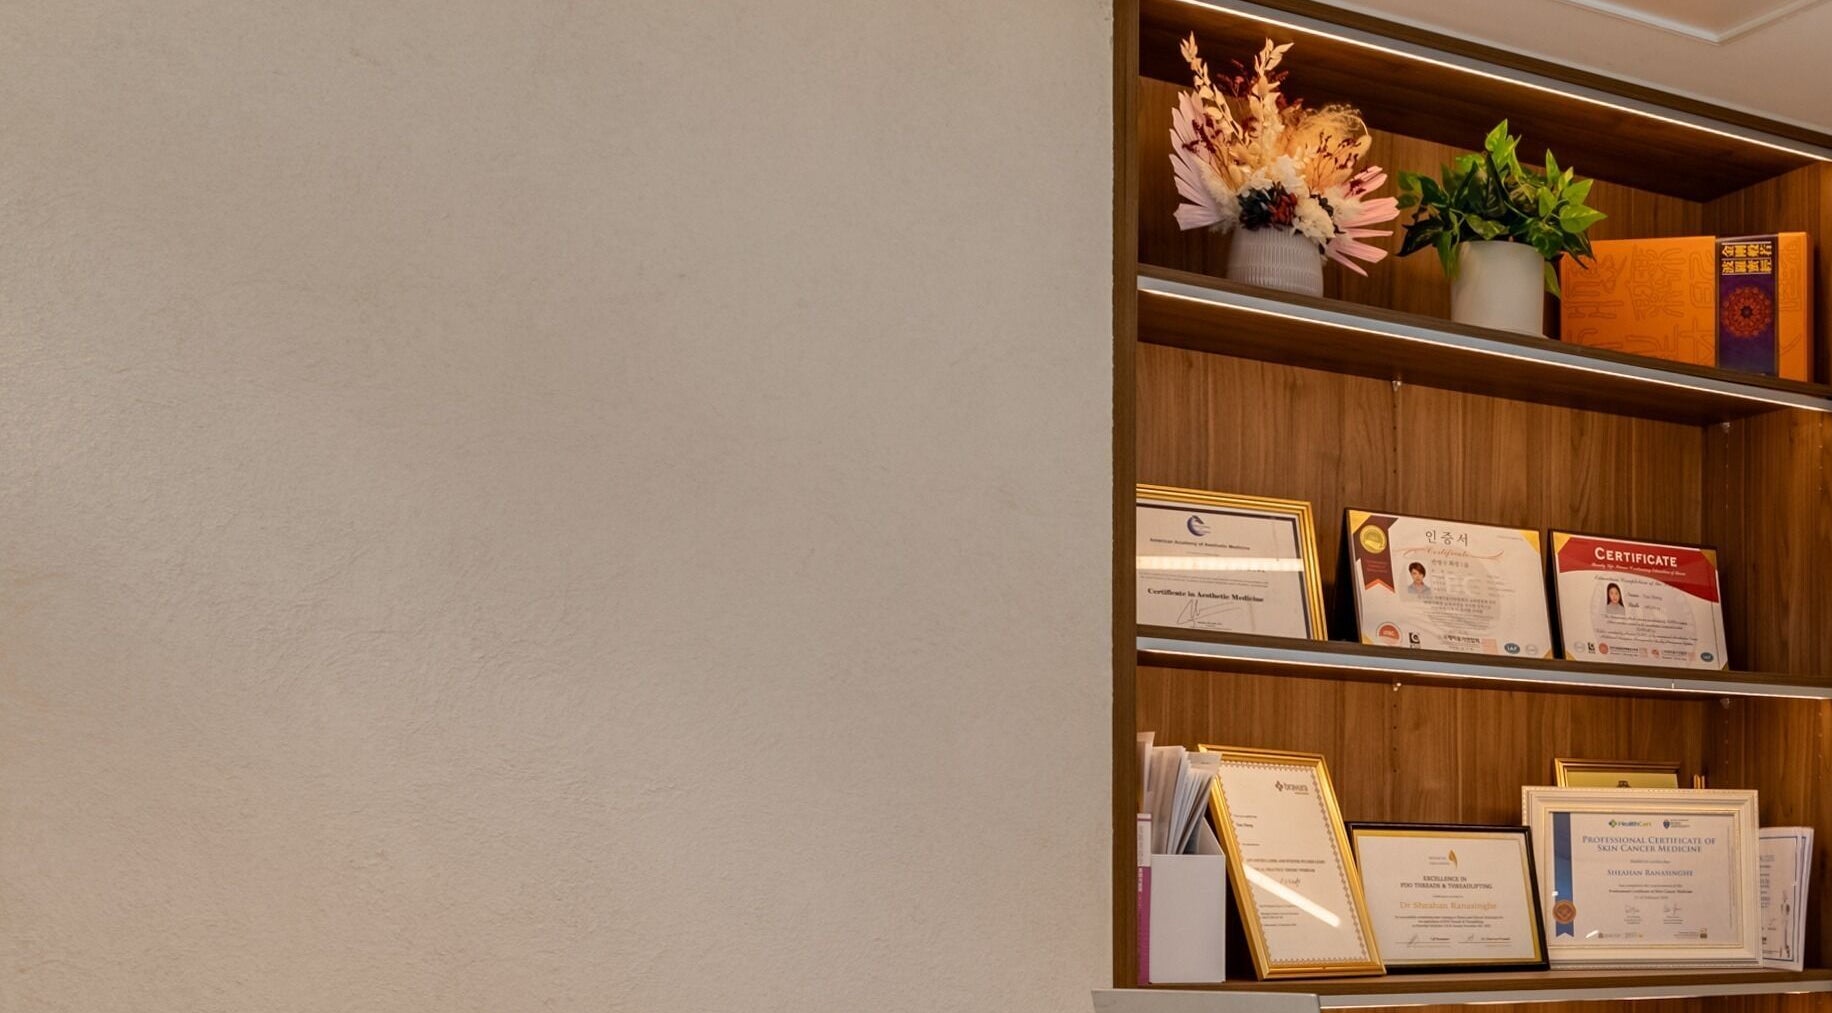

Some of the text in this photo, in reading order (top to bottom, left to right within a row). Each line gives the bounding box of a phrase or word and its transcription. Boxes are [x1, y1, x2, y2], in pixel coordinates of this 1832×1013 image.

[1425, 528, 1469, 548] 인증서
[1594, 547, 1678, 568] CERTIFICATE
[1147, 588, 1265, 603] Certificate in Aesthetic Medicine
[1582, 835, 1717, 845] PROFESSIONAL CERTIFICATE OF
[1597, 844, 1702, 853] SKIN CANCER MEDICINE
